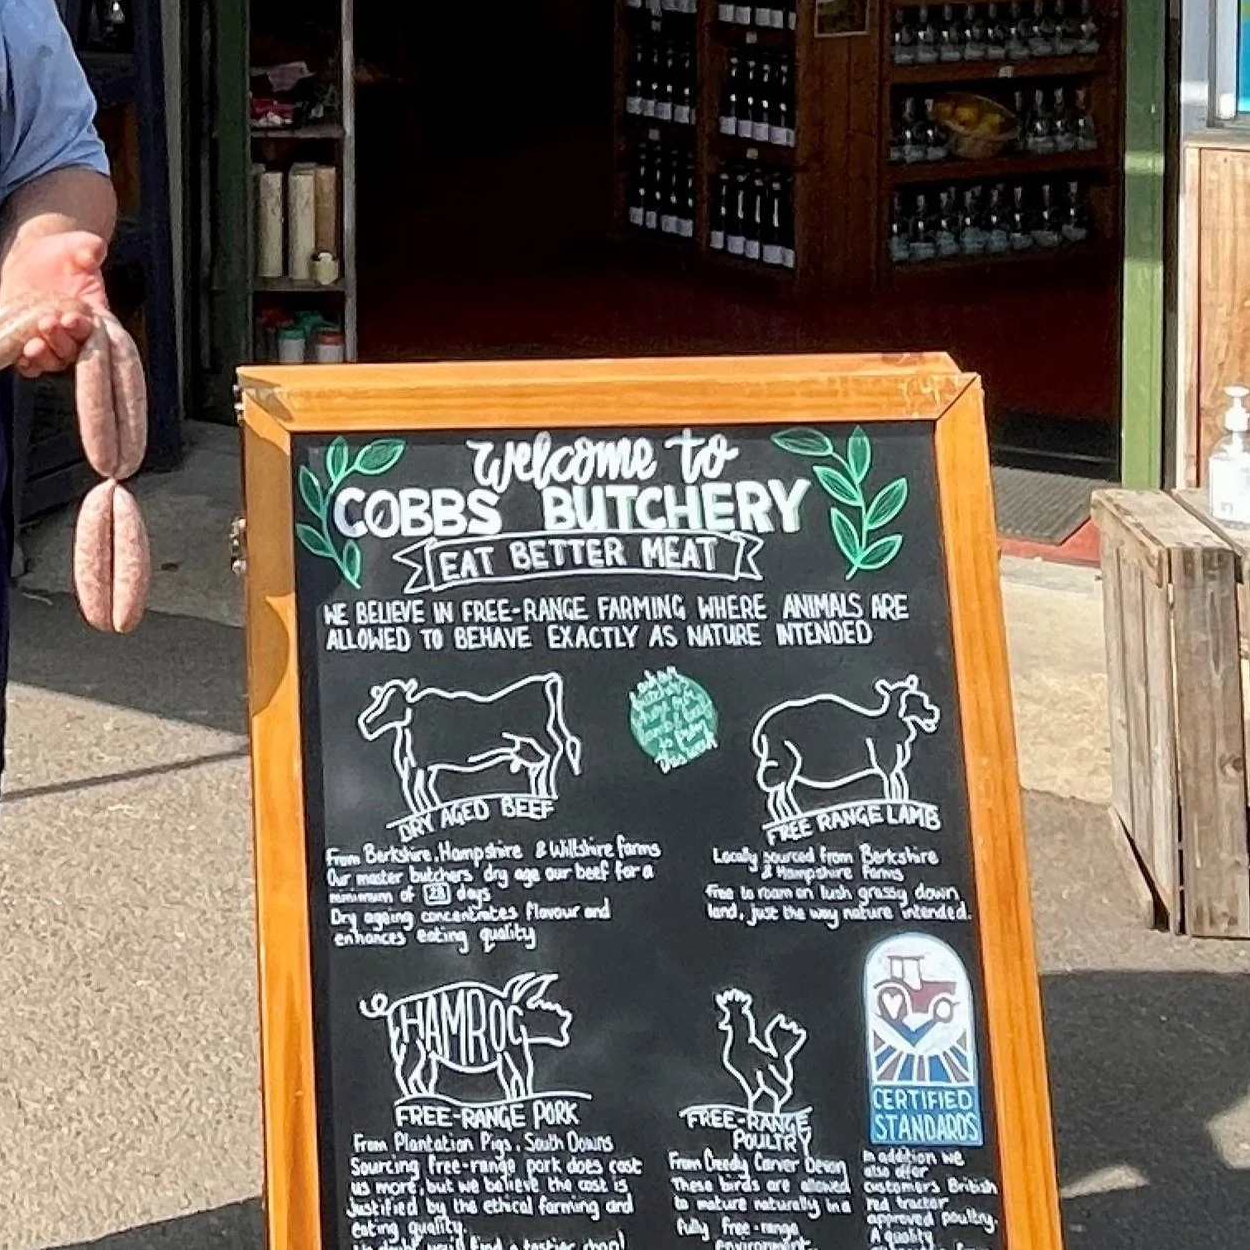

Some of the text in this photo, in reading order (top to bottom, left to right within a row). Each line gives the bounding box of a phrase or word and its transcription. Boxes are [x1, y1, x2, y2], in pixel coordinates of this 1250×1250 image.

[466, 428, 738, 493] Welcome to
[333, 479, 811, 538] COBBS BUTCHERY
[439, 536, 718, 581] EAT BETTER MEAT
[324, 593, 909, 625] WE BELIEVE IN FREE-RANGE FARMING WHERE ANIMALS ARE
[326, 620, 873, 650] ALLOWED TO BEHAVE EXACTLY AS NATURE INTENDED
[399, 795, 554, 842] DRY AGED BEEF
[766, 803, 941, 846] FREE RANGE LAMB
[439, 840, 523, 868] Hampshire
[535, 840, 548, 859] &
[616, 834, 662, 859] farms
[713, 846, 758, 872] Locally
[762, 846, 815, 863] sourced
[859, 843, 939, 865] Berkshire
[327, 860, 655, 889] Our master butchers dry age our beef for a
[776, 866, 853, 885] Hampshire
[329, 888, 393, 904] minimum
[400, 884, 415, 903] of
[456, 883, 491, 910] days
[740, 885, 755, 900] to
[757, 887, 793, 899] roam
[796, 887, 814, 899] on
[820, 884, 852, 900] lush
[857, 885, 908, 908] grassy
[914, 882, 960, 900] down
[330, 908, 357, 932] Dry
[421, 905, 519, 924] concentrates
[584, 897, 611, 919] and
[746, 903, 779, 927] just
[782, 905, 806, 920] the
[809, 908, 840, 930] way
[843, 905, 894, 920] nature
[333, 922, 536, 954] enhances eating quality
[401, 988, 524, 1066] HAMROC
[873, 1087, 972, 1110] CERTIFIED
[395, 1100, 580, 1131] FREE-RANGE PORK
[687, 1110, 811, 1134] FREE-RANGE
[875, 1112, 979, 1142] STANDARDS
[353, 1133, 388, 1152] From
[393, 1131, 474, 1152] Plantation
[524, 1132, 565, 1152] South
[567, 1130, 614, 1152] Downs
[733, 1128, 811, 1156] POULTRY
[350, 1154, 420, 1181] Sourcing
[526, 1157, 563, 1178] pork
[566, 1156, 603, 1175] does
[609, 1157, 643, 1175] cost
[668, 1151, 701, 1171] From
[754, 1151, 800, 1172] Carver
[804, 1155, 847, 1175] Devon
[878, 1145, 937, 1165] addition
[941, 1151, 965, 1166] we
[350, 1181, 370, 1196] us
[425, 1177, 455, 1194] but
[458, 1178, 480, 1194] we
[483, 1176, 539, 1193] believe
[548, 1176, 572, 1193] the
[578, 1177, 608, 1193] cost
[613, 1175, 629, 1193] is
[670, 1177, 713, 1192] These
[718, 1174, 760, 1192] birds
[766, 1178, 790, 1193] are
[863, 1176, 999, 1194] customers British
[895, 1164, 929, 1180] offer
[425, 1197, 447, 1216] by
[453, 1198, 478, 1215] the
[483, 1195, 534, 1215] ethical
[539, 1195, 600, 1221] farming
[606, 1193, 634, 1214] and
[674, 1195, 689, 1210] to
[696, 1195, 747, 1211] mature
[754, 1196, 822, 1219] naturally
[842, 1200, 852, 1213] a
[866, 1212, 935, 1229] approved
